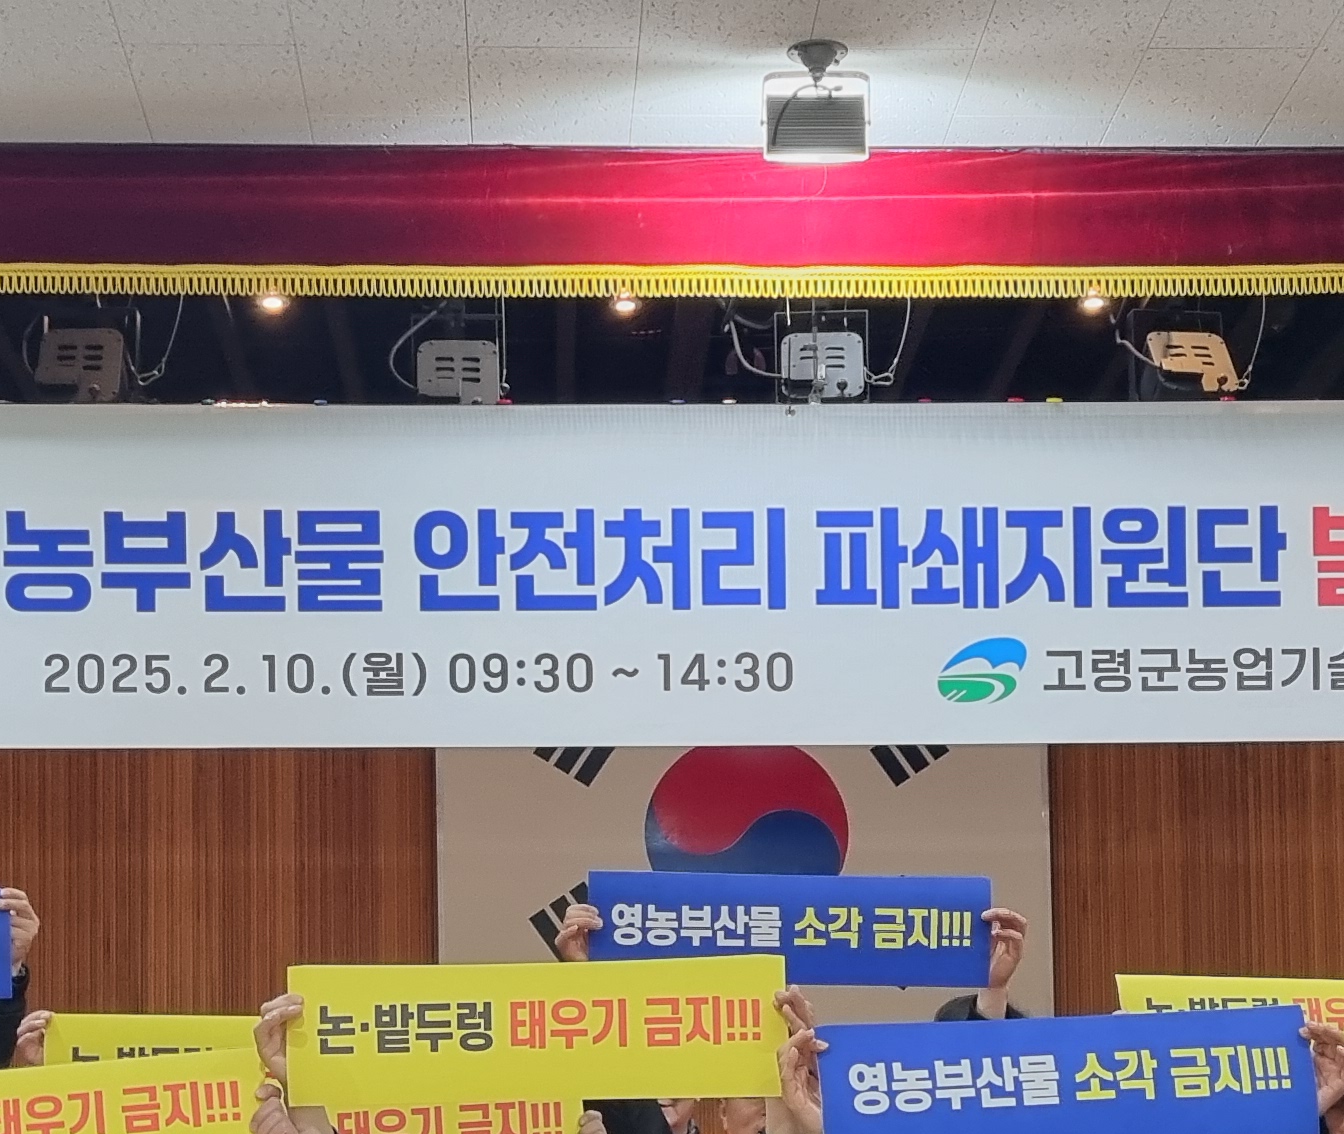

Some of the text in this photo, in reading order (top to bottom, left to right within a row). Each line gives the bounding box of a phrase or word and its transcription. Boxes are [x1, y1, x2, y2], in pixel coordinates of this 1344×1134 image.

[414, 508, 786, 611] 안전처리
[816, 506, 1286, 609] 파쇄지원단
[45, 654, 186, 695] 2025.
[204, 654, 245, 695] 2.
[450, 653, 593, 693] 09:30
[658, 652, 793, 692] 14:30
[612, 903, 972, 949] 영농부산물 소각 금지!!!
[317, 996, 761, 1054] 논·밭두렁 태우기 금지!!!
[122, 1081, 241, 1133] 금지!!!
[849, 1045, 1291, 1114] 영농부산물 소각 금지!!!
